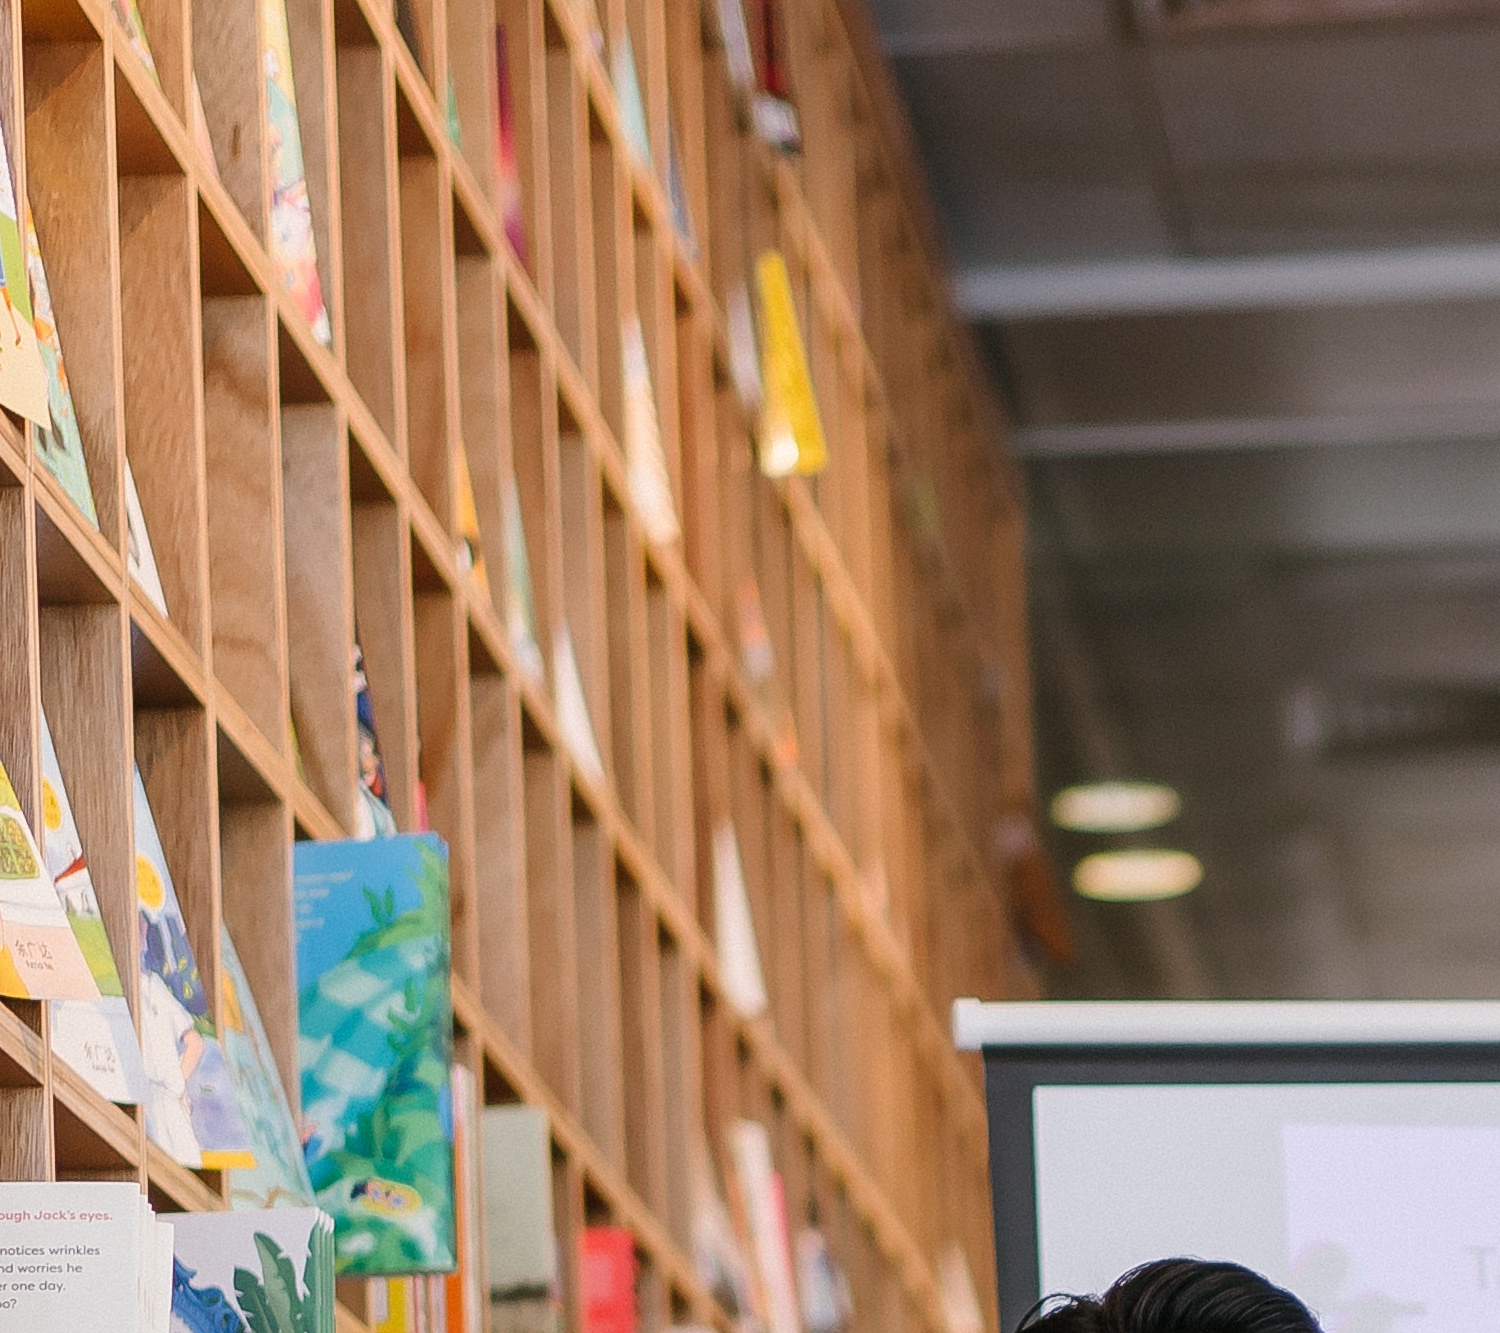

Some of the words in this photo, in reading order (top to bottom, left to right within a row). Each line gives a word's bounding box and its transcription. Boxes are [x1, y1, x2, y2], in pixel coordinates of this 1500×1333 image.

[34, 1210, 76, 1222] Jack's
[79, 1213, 113, 1223] eyes.
[0, 1245, 45, 1256] notices
[49, 1245, 100, 1256] wrinkles
[17, 1263, 63, 1273] worries
[66, 1263, 83, 1273] he
[11, 1282, 36, 1291] one
[39, 1281, 66, 1293] day.
